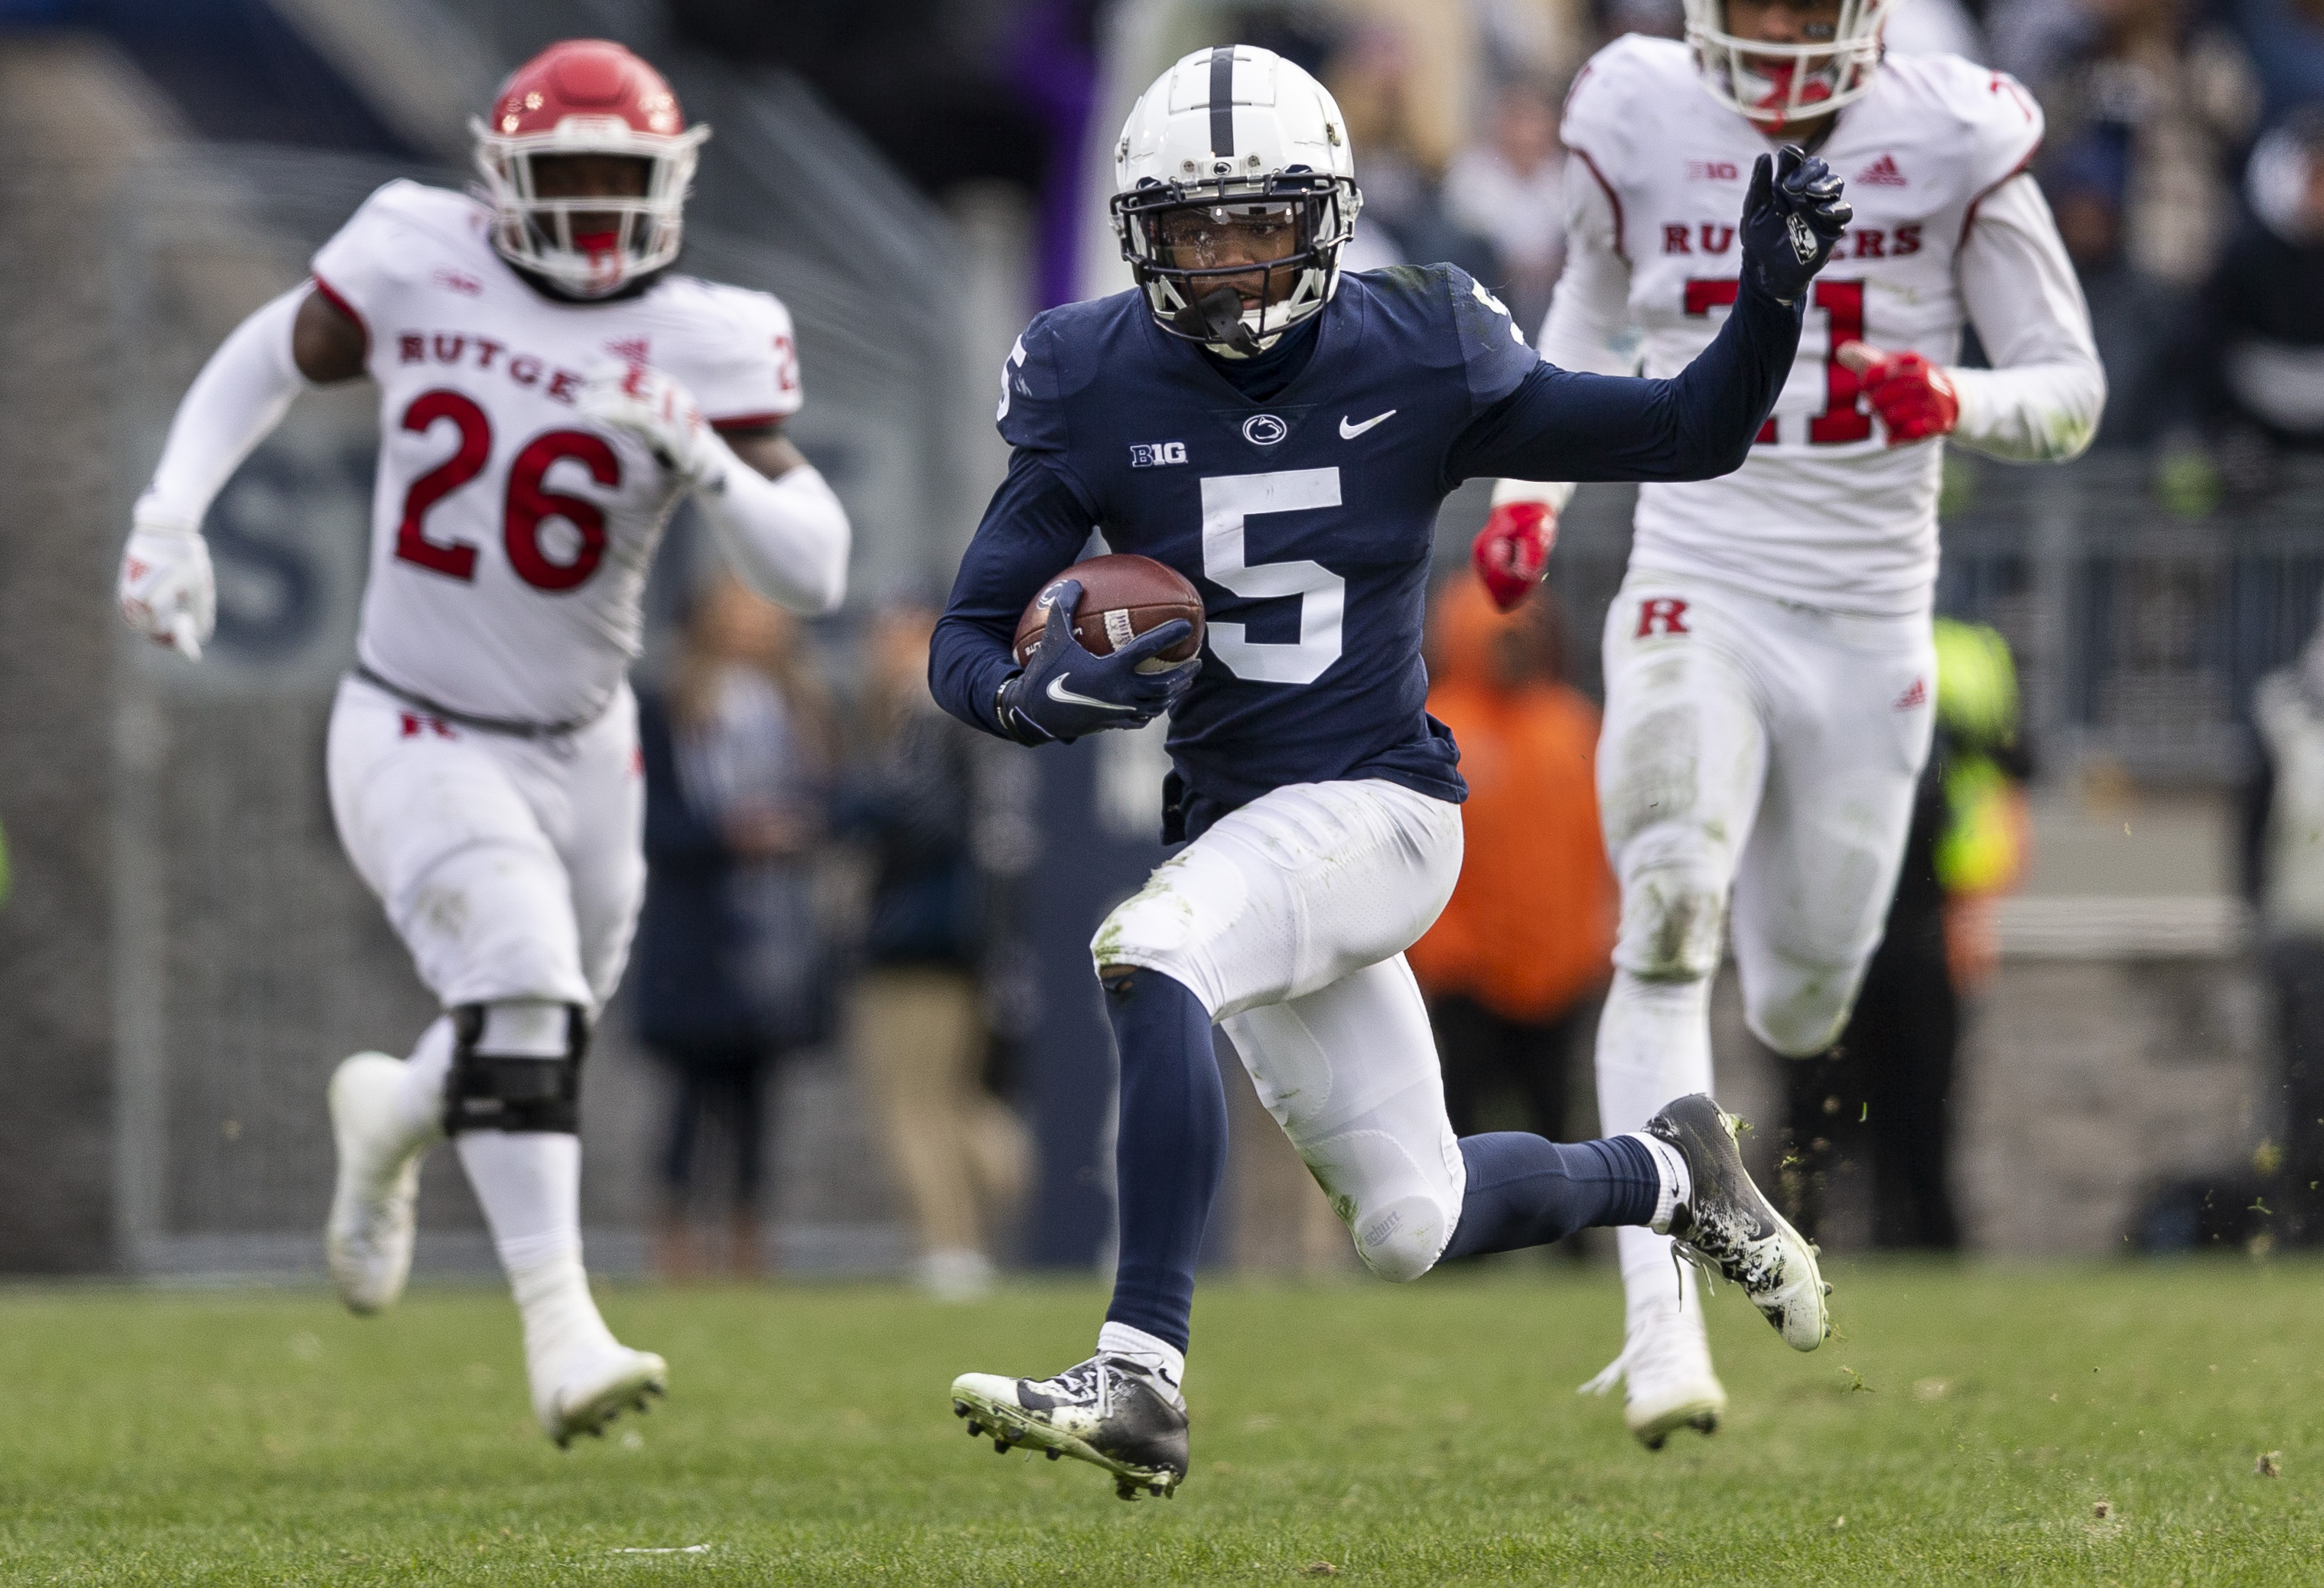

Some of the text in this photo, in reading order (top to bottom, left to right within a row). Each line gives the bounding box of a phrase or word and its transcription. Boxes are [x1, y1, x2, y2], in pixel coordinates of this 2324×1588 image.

[1663, 221, 1923, 259] RURS
[399, 334, 588, 406] RUTGE
[395, 389, 622, 592] 26
[1199, 467, 1345, 685] 5
[1636, 597, 1691, 639] R
